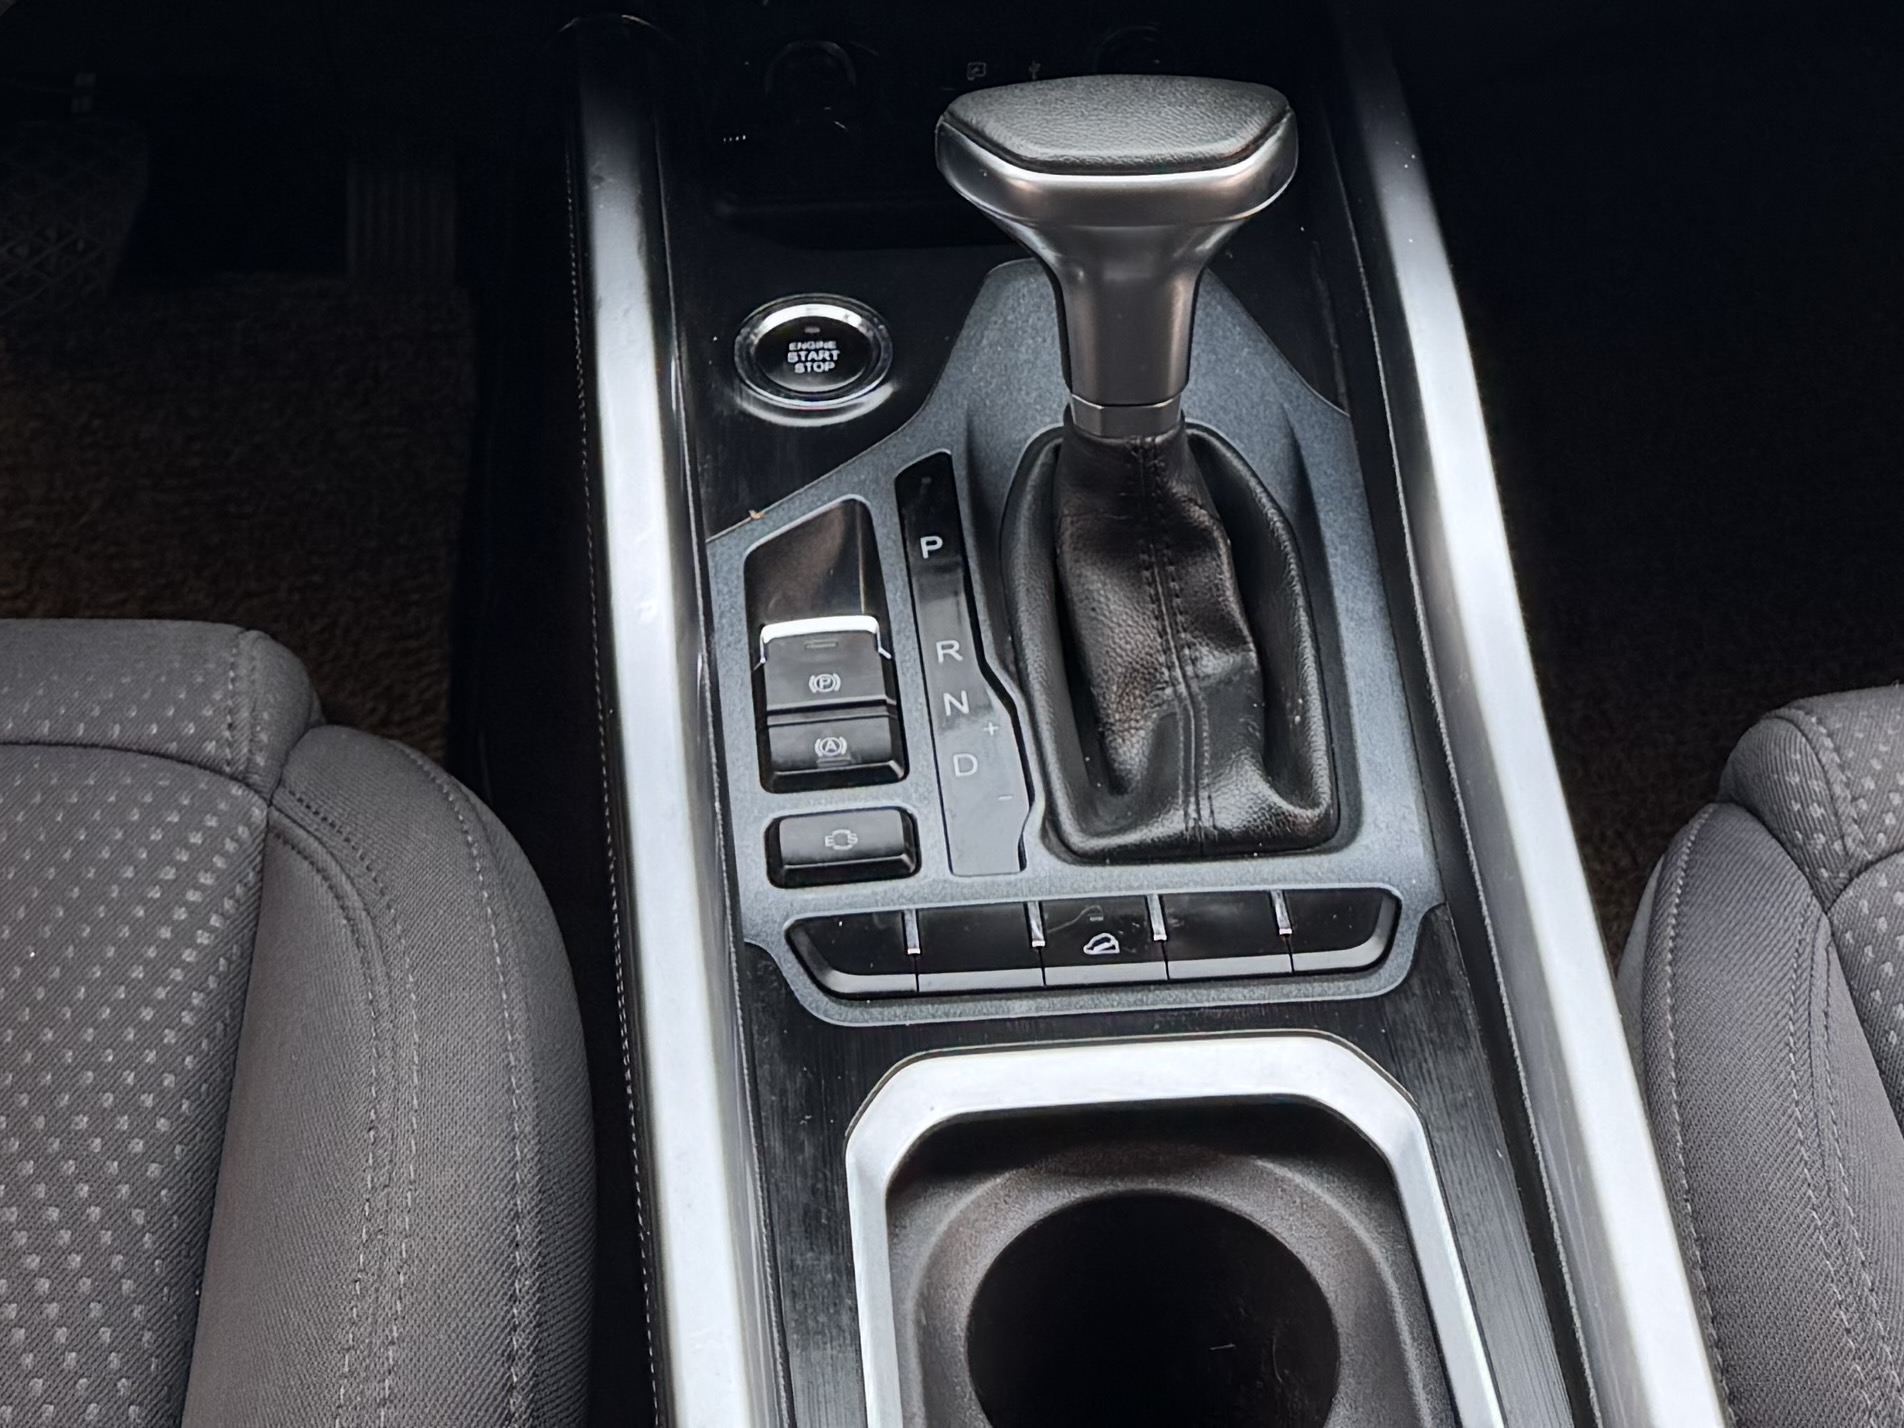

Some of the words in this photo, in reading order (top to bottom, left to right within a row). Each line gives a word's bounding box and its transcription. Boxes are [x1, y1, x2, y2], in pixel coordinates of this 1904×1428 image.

[787, 349, 840, 363] START
[788, 340, 837, 351] ENGINE
[794, 361, 836, 374] STOP
[920, 535, 944, 559] P
[935, 640, 964, 664] R
[943, 690, 970, 716] N
[952, 753, 978, 777] D
